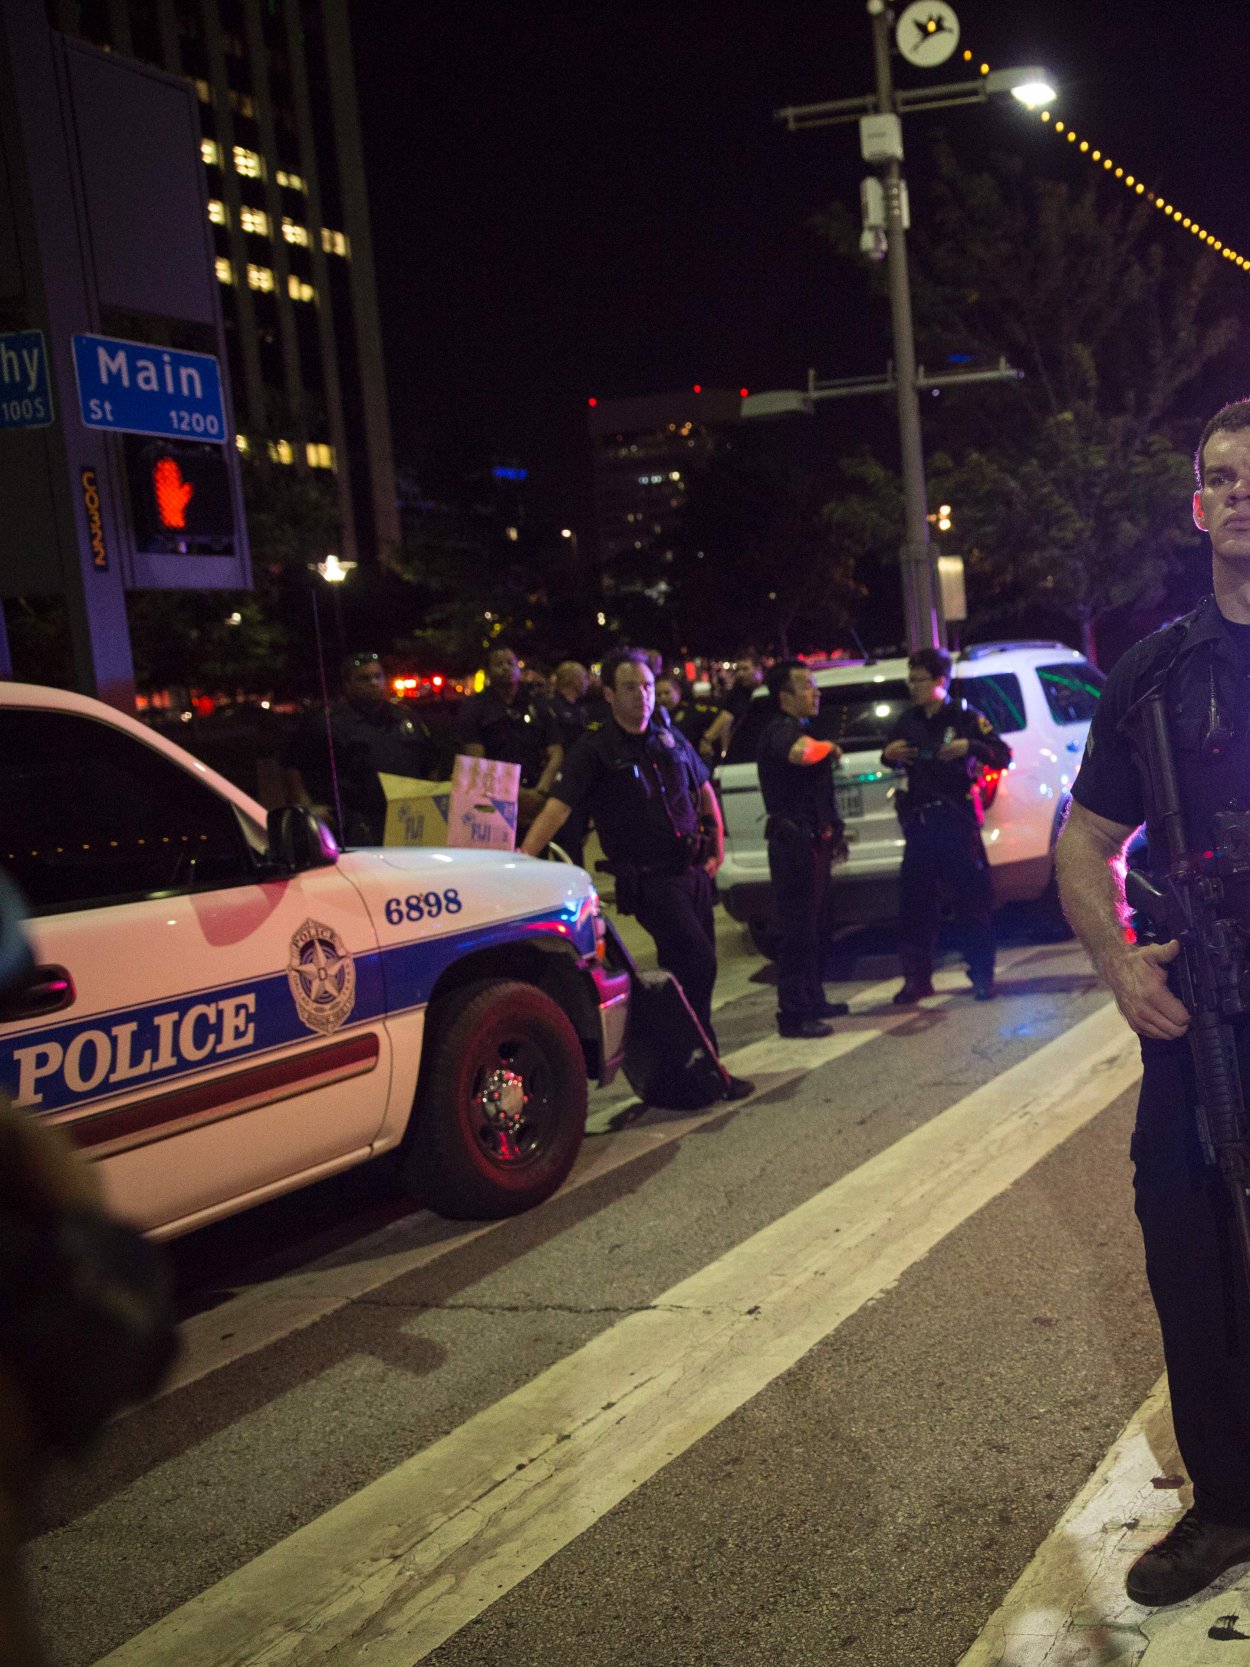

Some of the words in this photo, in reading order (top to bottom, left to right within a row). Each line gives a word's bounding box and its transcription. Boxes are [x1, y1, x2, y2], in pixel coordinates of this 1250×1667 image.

[96, 345, 203, 399] Main
[89, 398, 114, 421] St
[169, 409, 220, 435] 1200
[384, 888, 462, 926] 6898
[11, 992, 256, 1109] POLICE
